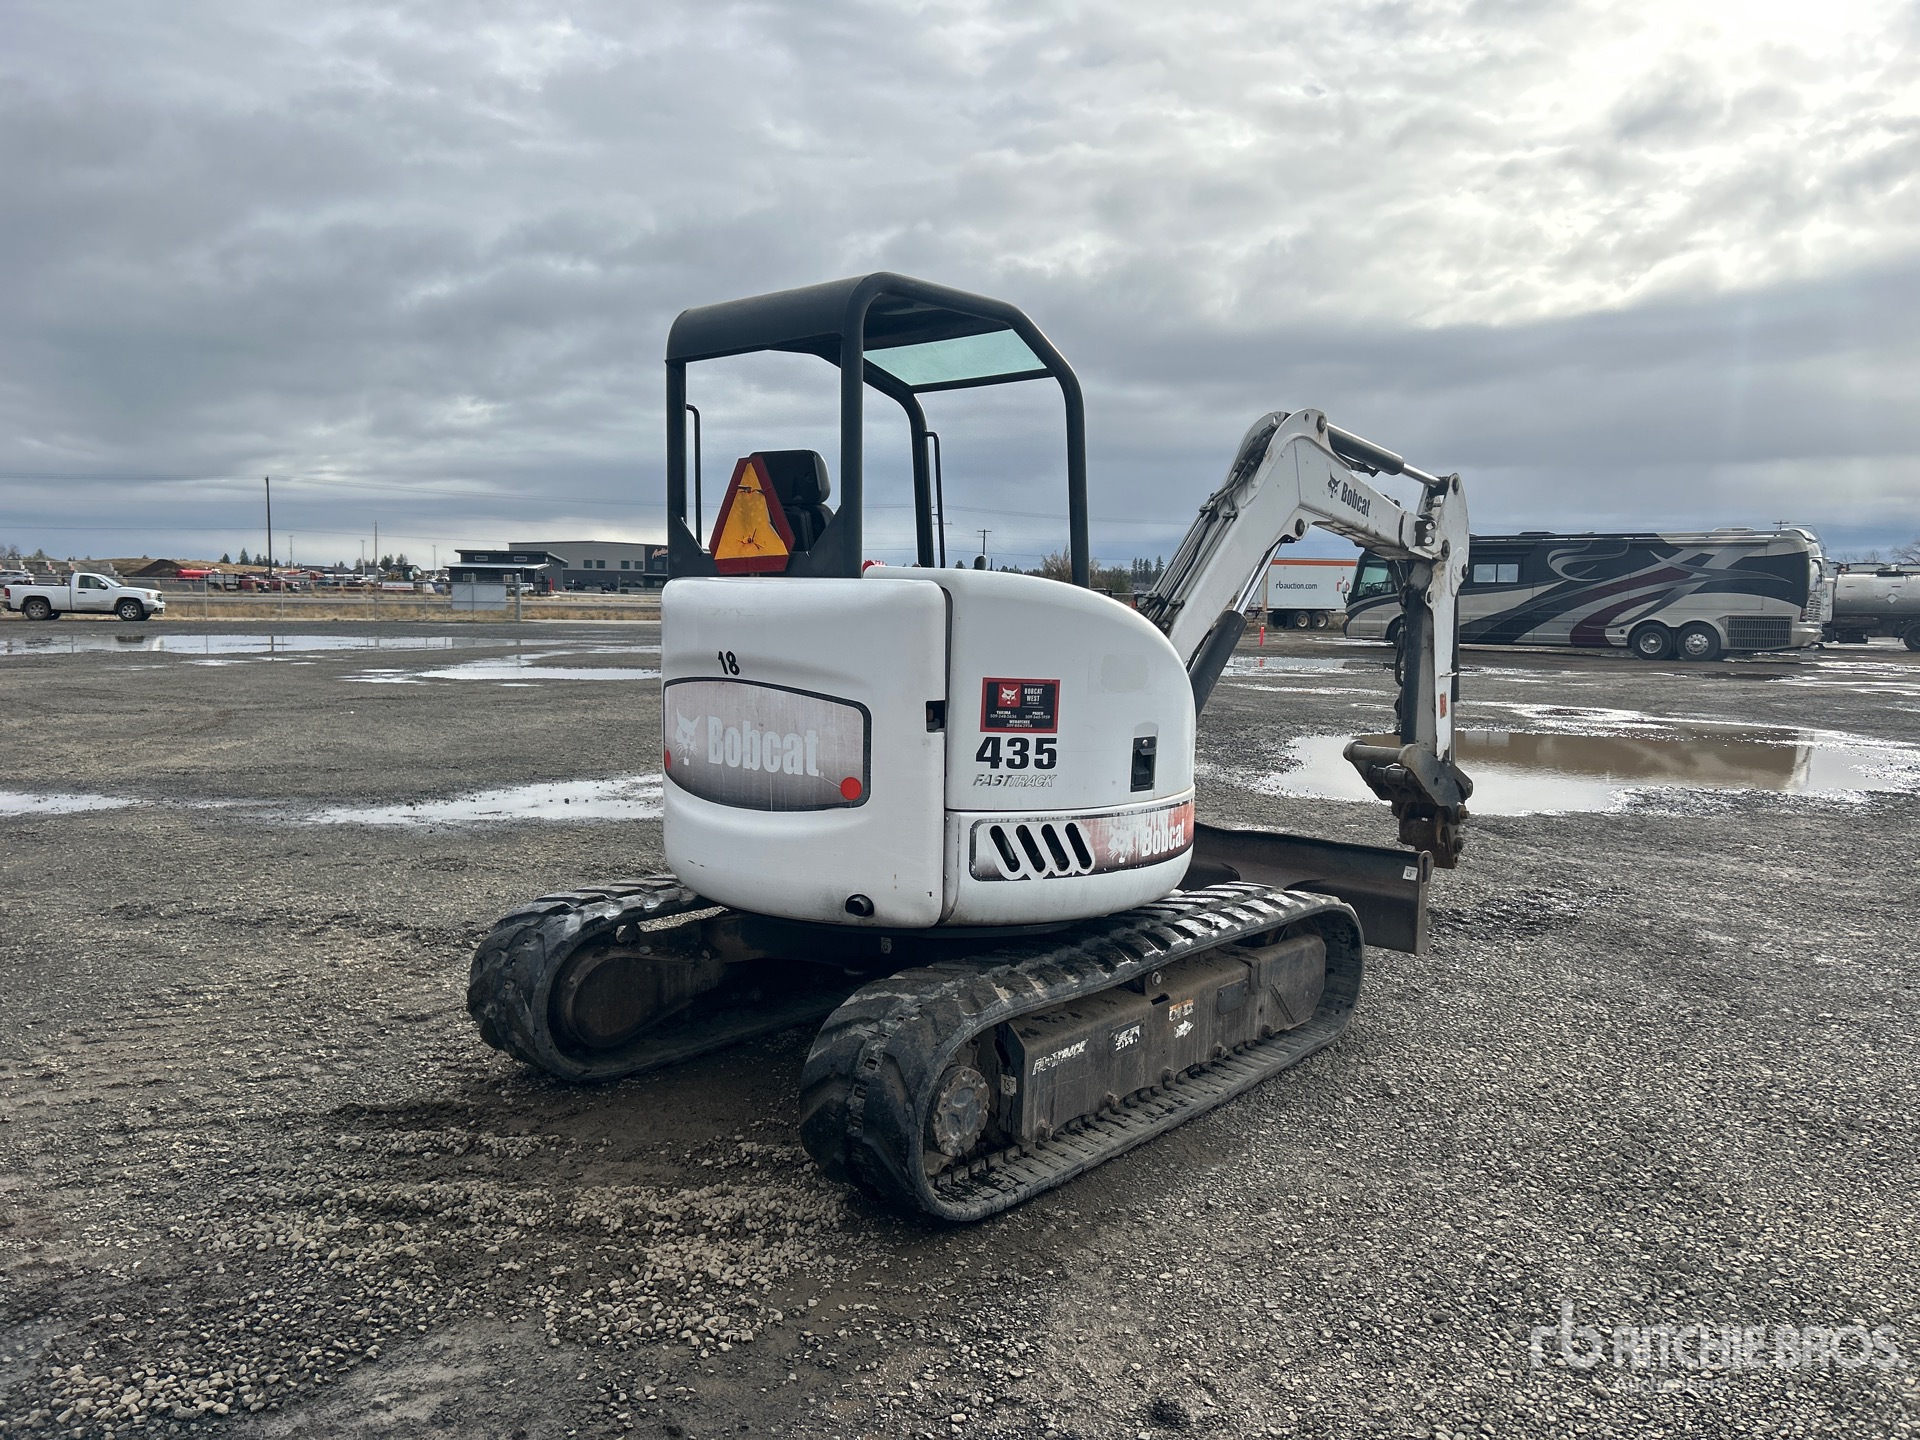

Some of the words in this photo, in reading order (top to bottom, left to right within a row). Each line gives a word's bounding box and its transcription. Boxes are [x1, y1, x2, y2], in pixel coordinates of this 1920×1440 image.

[1341, 482, 1371, 517] Bobcat
[1276, 581, 1318, 590] rbauction.com
[718, 651, 740, 675] 18
[708, 716, 820, 777] Bobcat
[976, 737, 1057, 769] 435
[1142, 818, 1185, 857] Bobcat
